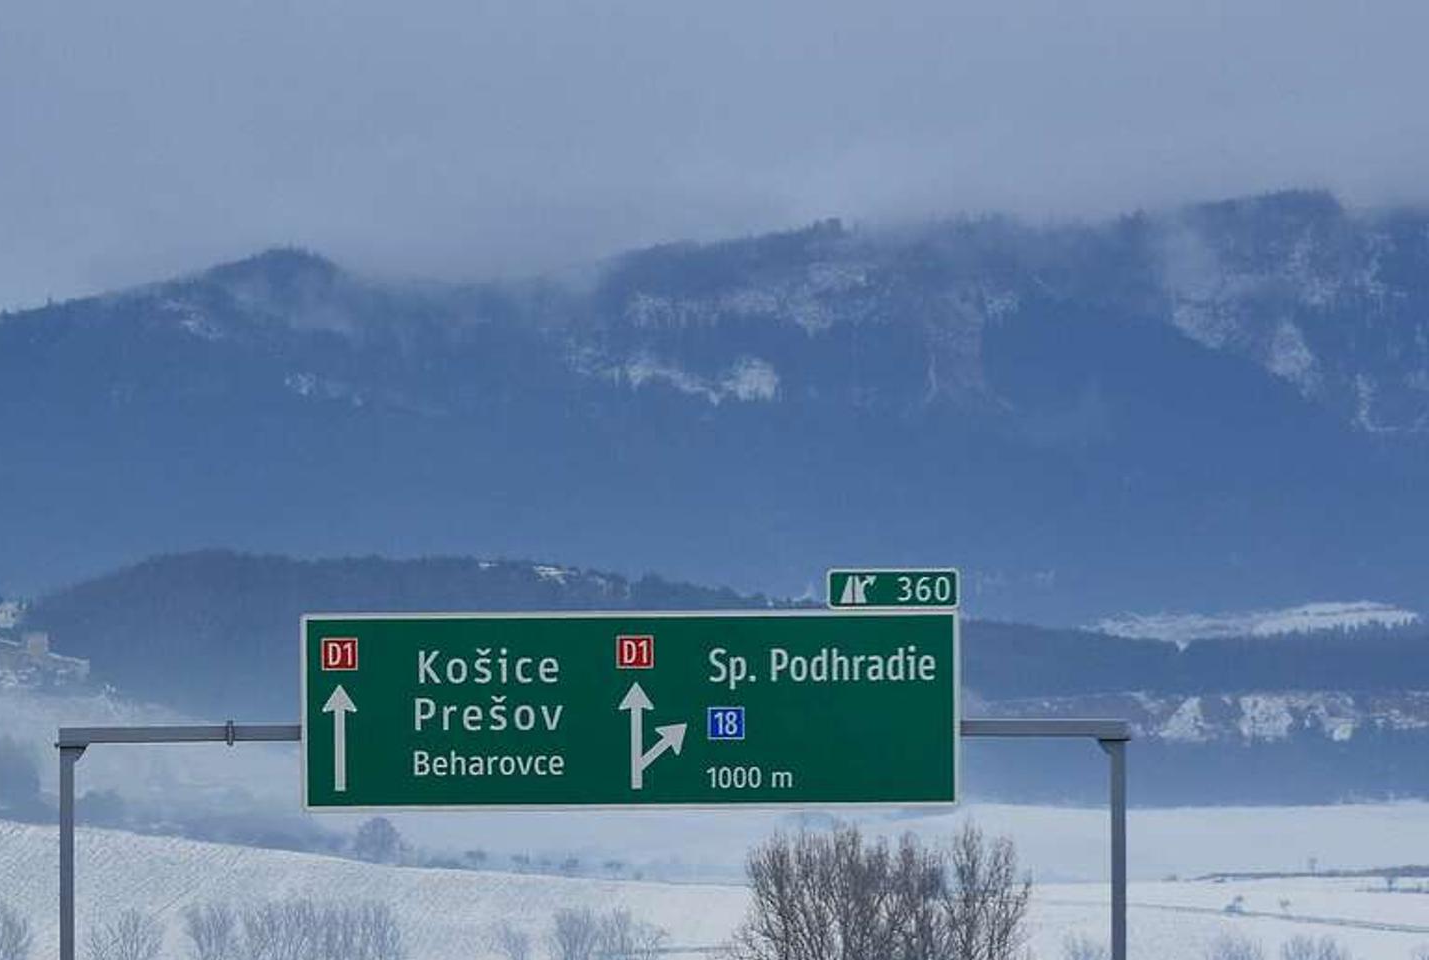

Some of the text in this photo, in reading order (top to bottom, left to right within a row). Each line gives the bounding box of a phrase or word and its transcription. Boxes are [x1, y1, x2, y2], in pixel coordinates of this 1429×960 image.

[897, 576, 951, 603] 360
[326, 641, 354, 666] D1
[621, 640, 649, 664] D1
[418, 647, 560, 684] Košice
[709, 645, 937, 690] Sp. Podhradie
[414, 695, 564, 731] Prešov
[714, 710, 739, 736] 18
[413, 750, 566, 776] Beharovce
[706, 766, 794, 789] 1000 m
